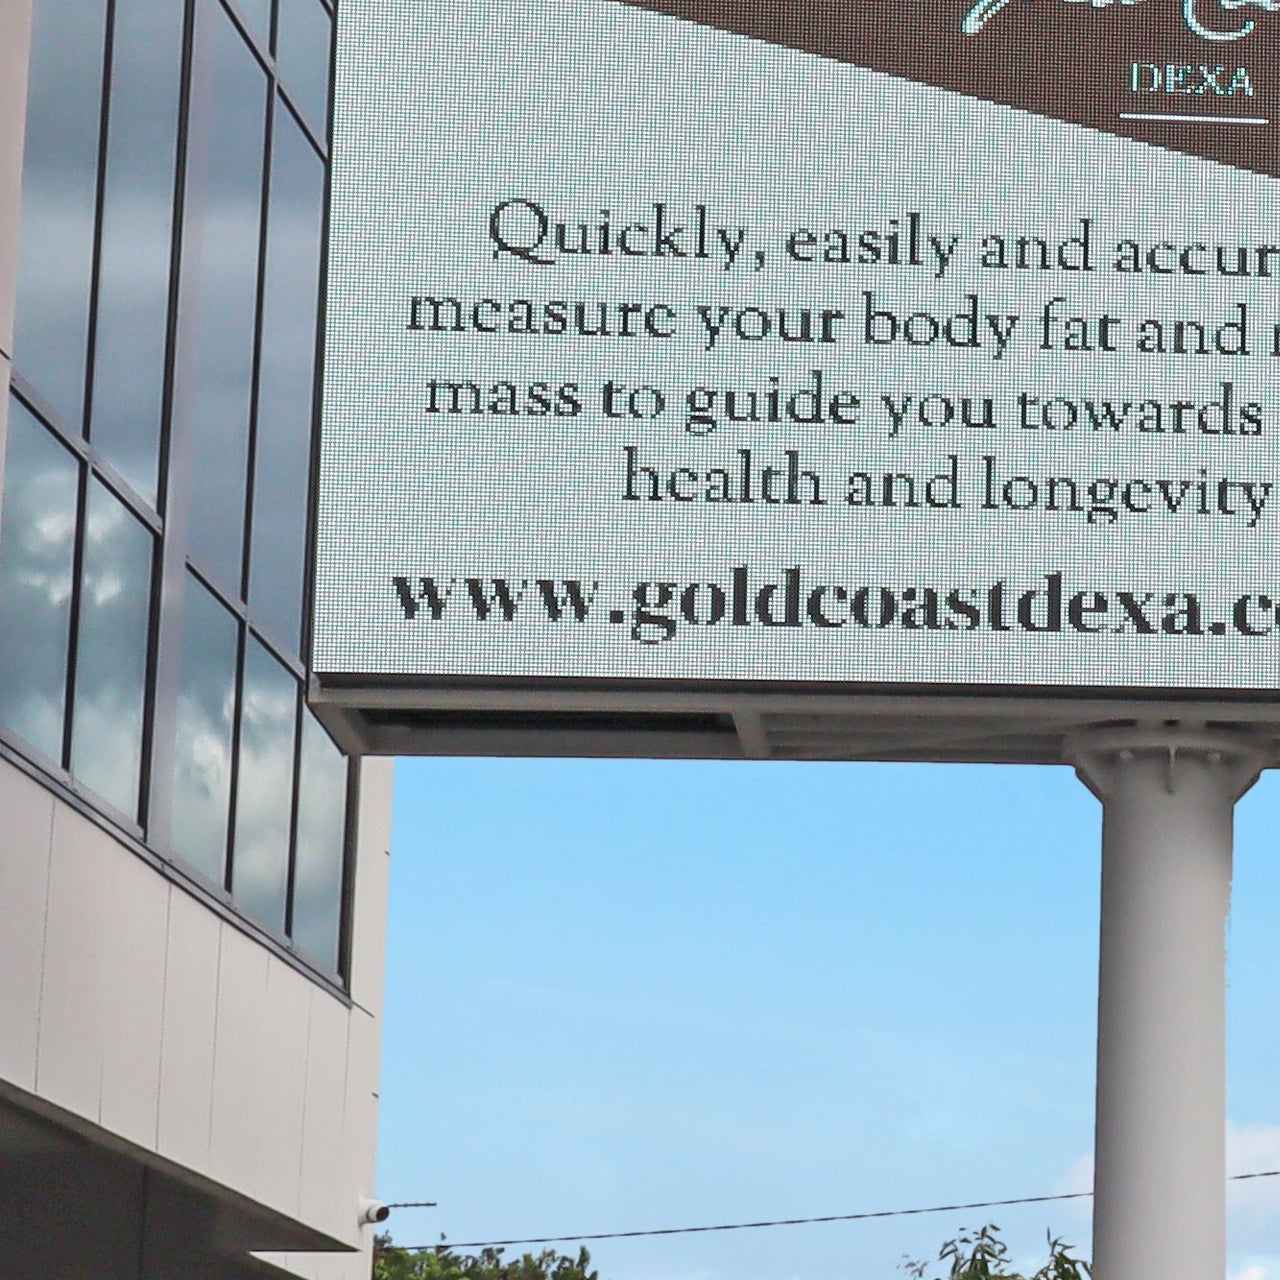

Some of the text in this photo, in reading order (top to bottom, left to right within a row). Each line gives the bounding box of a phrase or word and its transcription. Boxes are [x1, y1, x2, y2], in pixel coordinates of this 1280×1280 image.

[1130, 62, 1255, 96] DEXA
[488, 197, 767, 272] Quickly,
[785, 211, 959, 279] easily
[982, 218, 1094, 272] and
[405, 293, 677, 339] measure
[698, 303, 845, 351] your
[863, 291, 1019, 359] body
[1040, 296, 1121, 352] fat
[1136, 303, 1250, 357] and
[425, 377, 582, 417] mass
[602, 380, 666, 419] to
[685, 370, 861, 436] guide
[882, 392, 997, 437] you
[1018, 383, 1263, 435] towards
[622, 446, 1273, 527] health and longevity
